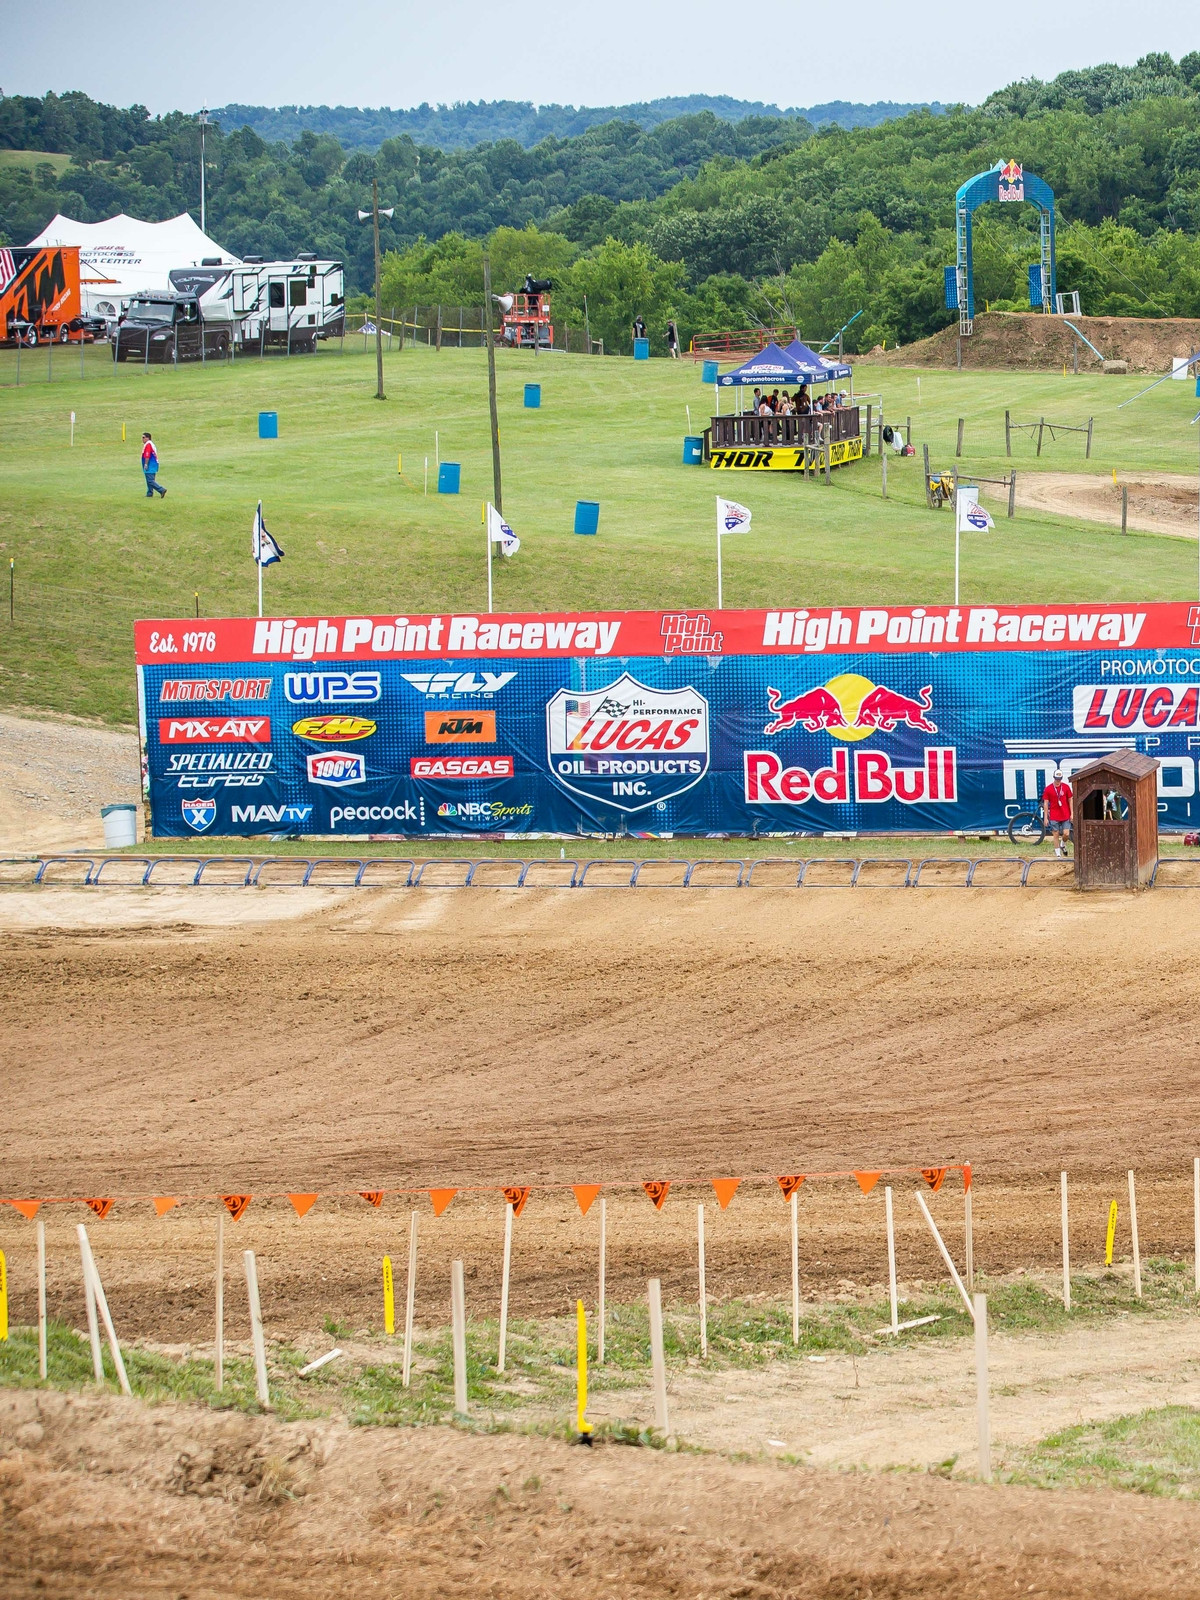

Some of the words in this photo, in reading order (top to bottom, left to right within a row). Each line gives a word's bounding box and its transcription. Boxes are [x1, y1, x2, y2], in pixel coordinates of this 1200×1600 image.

[999, 184, 1011, 201] Red
[1011, 184, 1024, 201] Bull
[742, 376, 786, 384] @promotocross
[711, 451, 774, 468] THOR
[661, 614, 711, 637] High
[762, 609, 851, 652] High
[855, 607, 960, 645] Point
[966, 608, 1146, 648] Raceway
[150, 632, 178, 653] Est.
[183, 631, 216, 653] 1976
[252, 619, 338, 659] High
[341, 618, 444, 653] Point
[448, 616, 621, 655] Raceway
[664, 632, 724, 653] Point
[286, 673, 380, 702] WPS
[400, 672, 518, 693] FLY
[425, 692, 494, 700] RACING
[168, 721, 210, 738] MX
[216, 720, 265, 737] ATV
[294, 718, 374, 735] FMF
[438, 718, 483, 734] KTM
[566, 719, 699, 751] LUCAS
[167, 753, 273, 771] SPECIALIZED
[315, 760, 359, 778] 100%
[414, 760, 510, 776] GASGAS
[558, 761, 591, 775] OIL
[597, 760, 701, 775] PRODUCTS
[177, 774, 264, 788] turbo
[744, 747, 850, 804] Red
[854, 746, 958, 804] Bull
[612, 781, 652, 796] INC.
[191, 808, 208, 825] X
[330, 800, 417, 828] peacock
[457, 802, 492, 816] NBC
[489, 802, 534, 818] Sports
